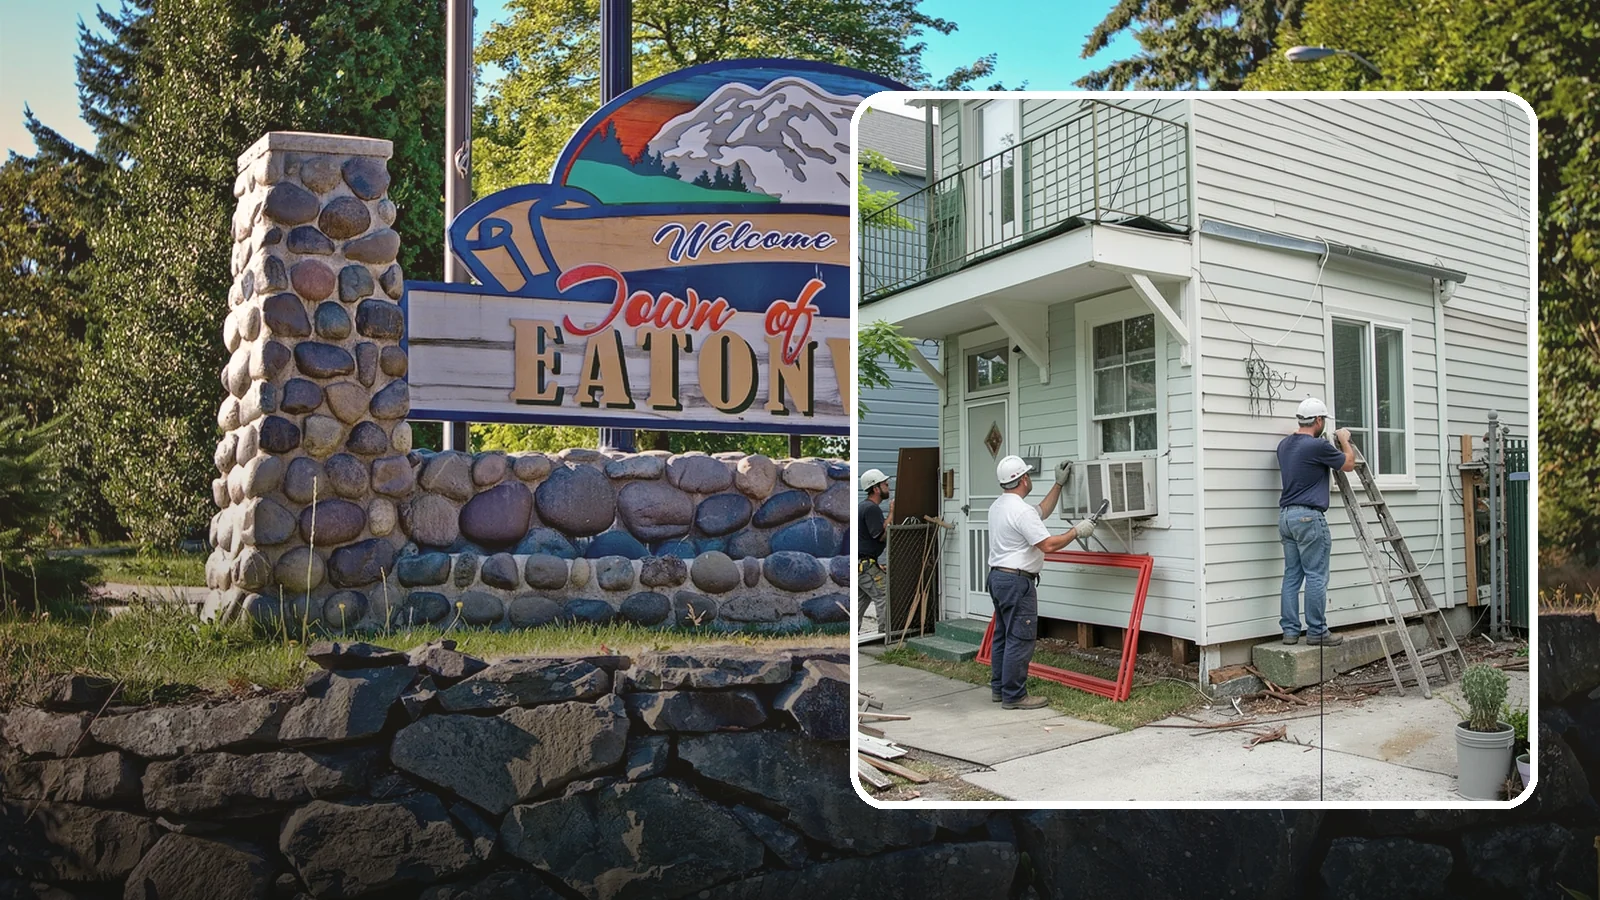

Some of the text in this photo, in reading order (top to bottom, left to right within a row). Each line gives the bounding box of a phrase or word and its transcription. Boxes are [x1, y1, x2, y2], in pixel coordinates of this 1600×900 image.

[654, 221, 837, 263] Welcome
[557, 263, 826, 365] Town of
